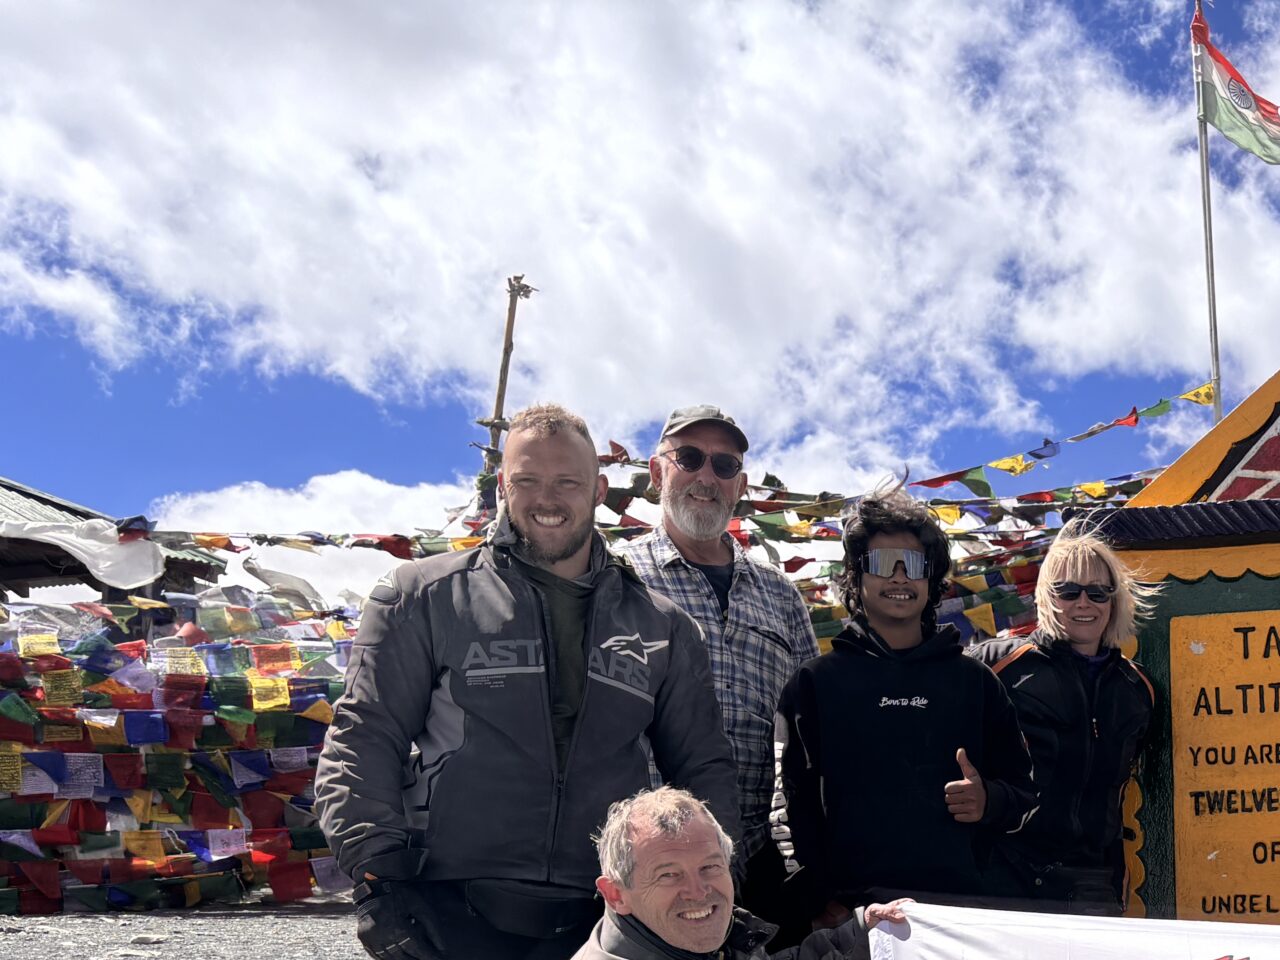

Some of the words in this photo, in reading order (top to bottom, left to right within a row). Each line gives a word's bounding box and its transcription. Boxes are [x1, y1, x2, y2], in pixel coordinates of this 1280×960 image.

[461, 638, 544, 669] AST
[879, 696, 900, 707] Born
[900, 698, 909, 706] to
[910, 696, 929, 709] Ride
[1189, 745, 1236, 767] YOU
